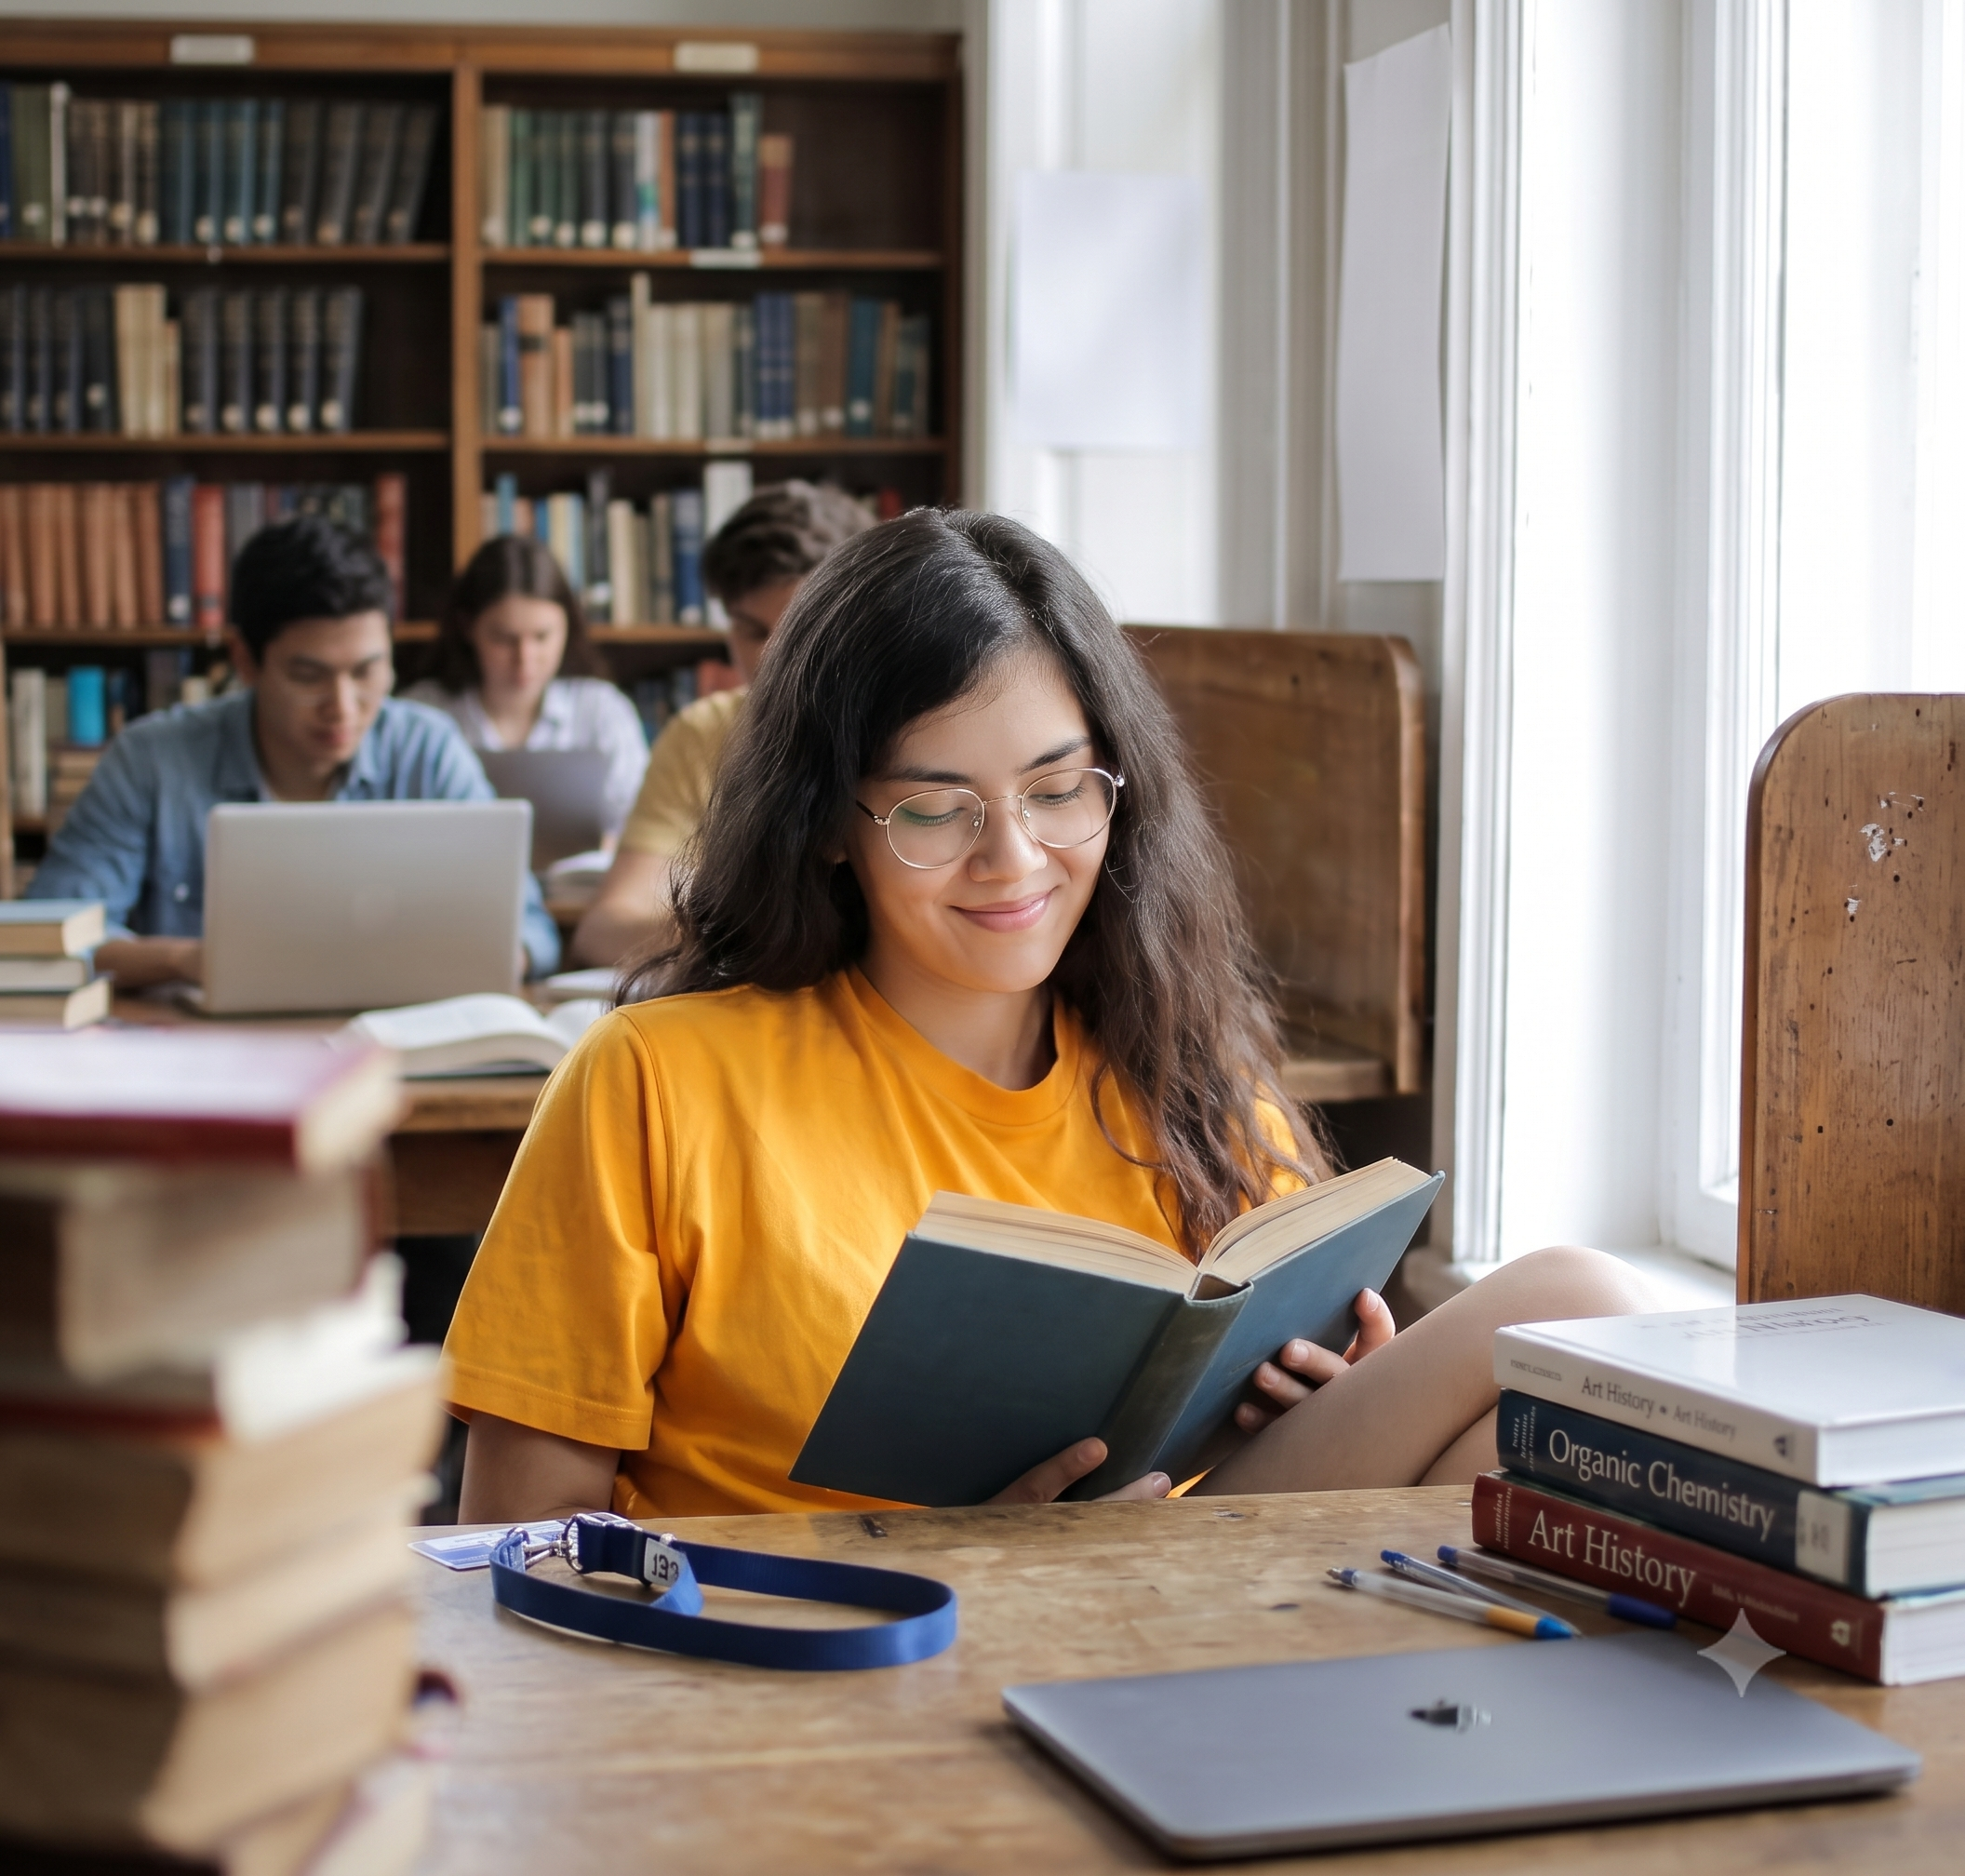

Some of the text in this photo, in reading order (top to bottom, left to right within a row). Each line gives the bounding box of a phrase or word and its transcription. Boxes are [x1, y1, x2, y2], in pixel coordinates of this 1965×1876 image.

[1581, 1376, 1603, 1399] Art
[1606, 1382, 1654, 1419] History
[1549, 1428, 1642, 1488] Organic
[1648, 1460, 1774, 1543] Chemistry
[1528, 1509, 1575, 1559] Art
[1584, 1524, 1696, 1608] History
